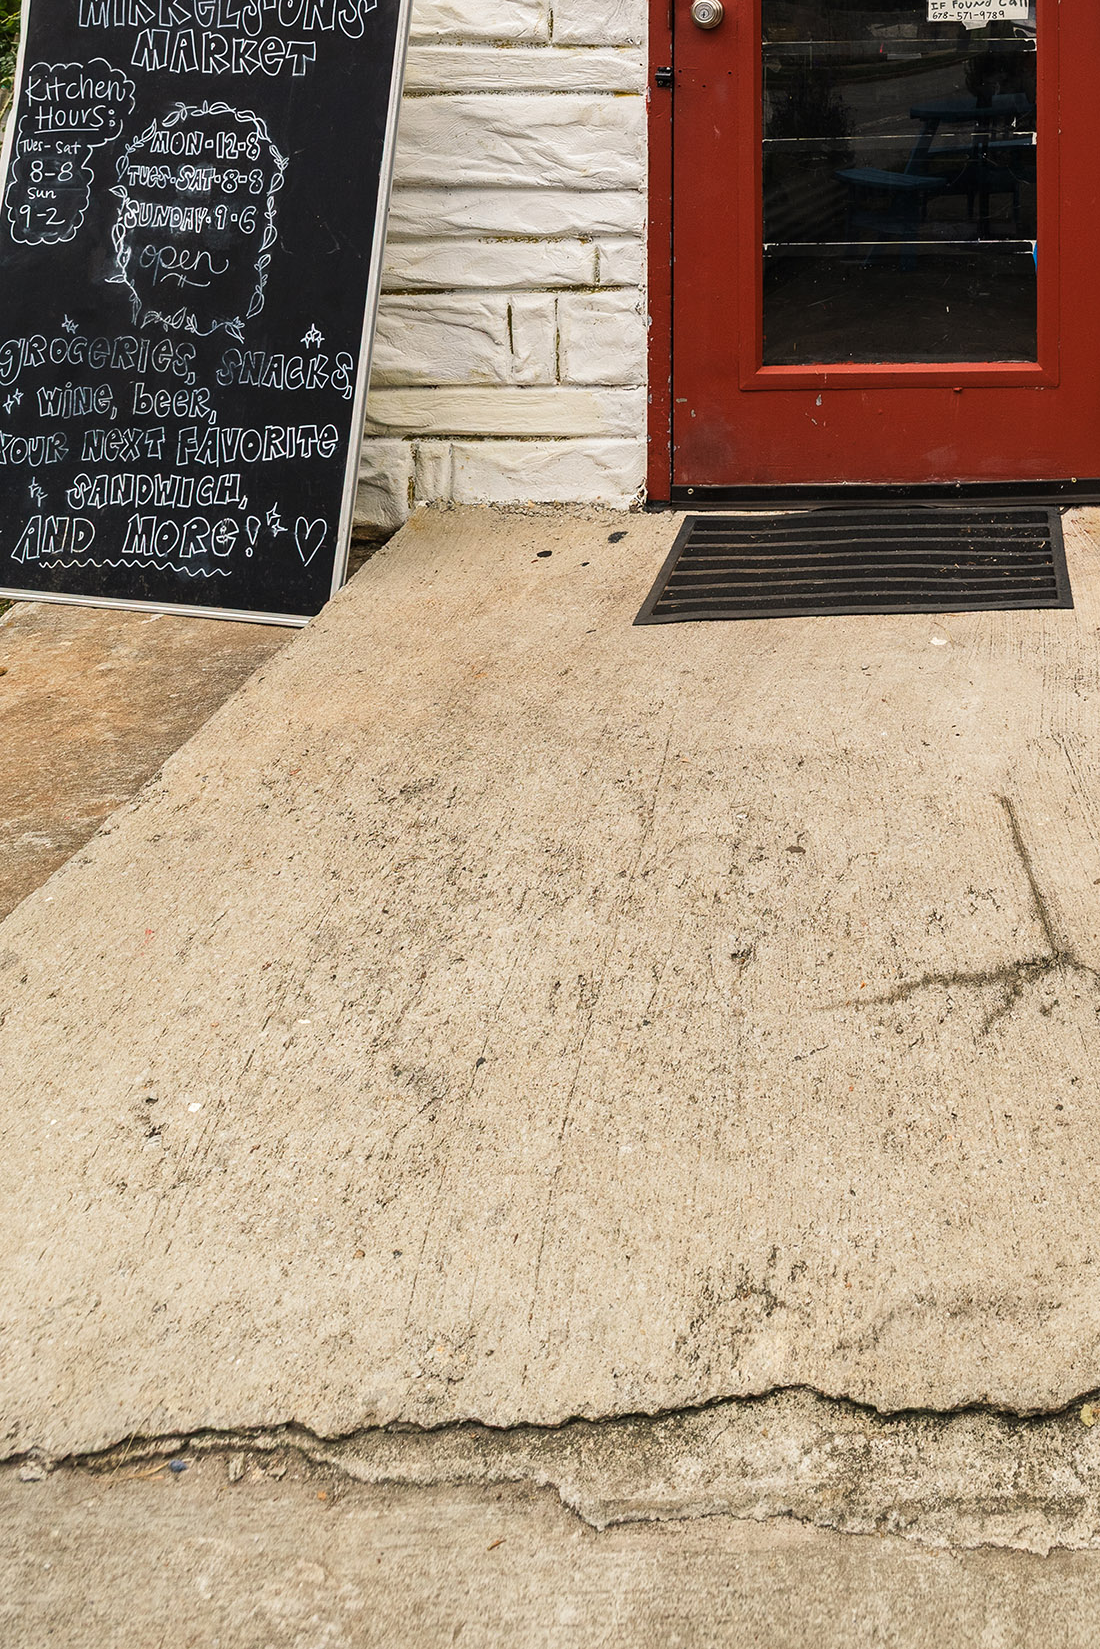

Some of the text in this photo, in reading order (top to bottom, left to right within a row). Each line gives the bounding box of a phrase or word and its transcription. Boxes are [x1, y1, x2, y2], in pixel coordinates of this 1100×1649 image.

[931, 1, 946, 10] IF
[932, 9, 1005, 20] 678-571-9789
[25, 74, 126, 107] Kitchen
[11, 515, 96, 564] AND
